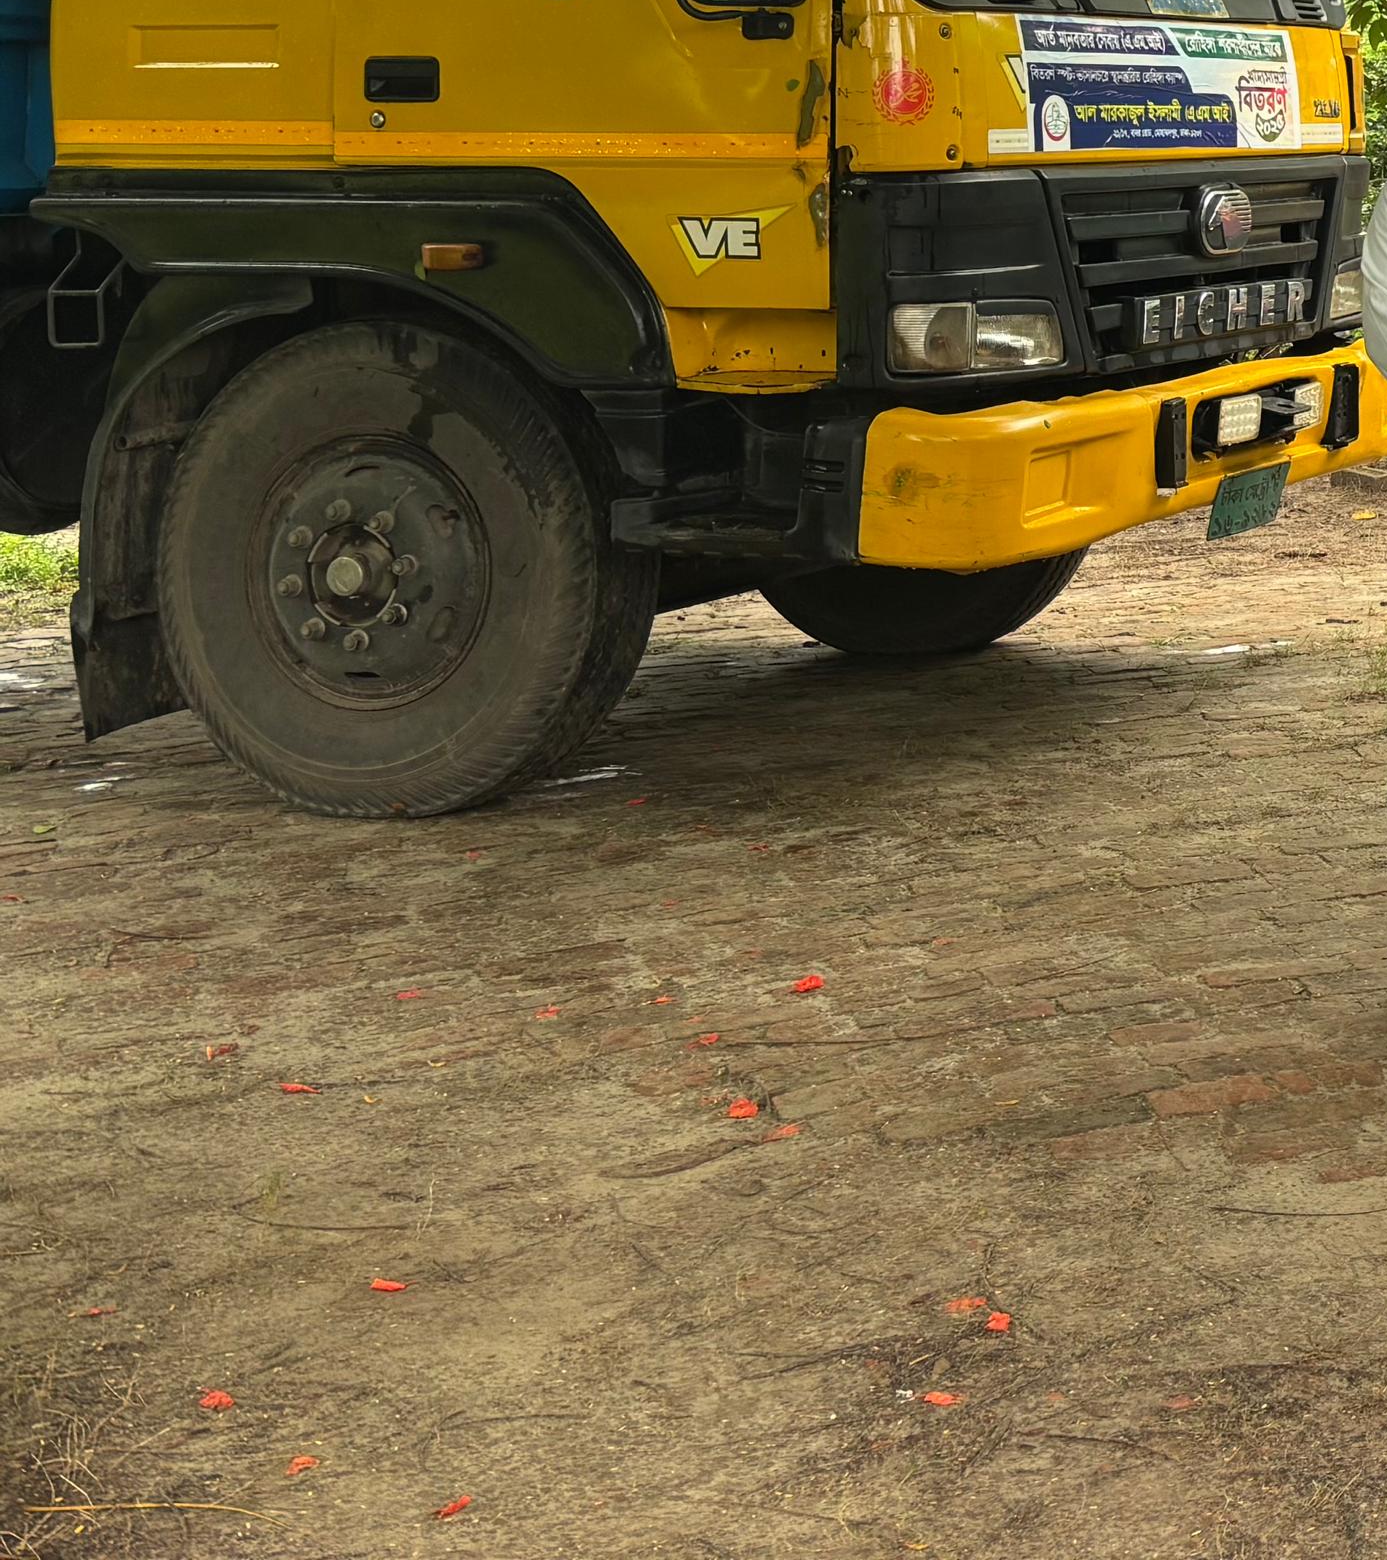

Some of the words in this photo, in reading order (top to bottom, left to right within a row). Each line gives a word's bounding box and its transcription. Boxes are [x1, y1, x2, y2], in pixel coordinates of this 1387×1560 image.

[1074, 104, 1097, 122] আল
[1235, 75, 1288, 115] বিতরণ
[677, 216, 762, 260] VE
[1142, 281, 1306, 344] EICHER
